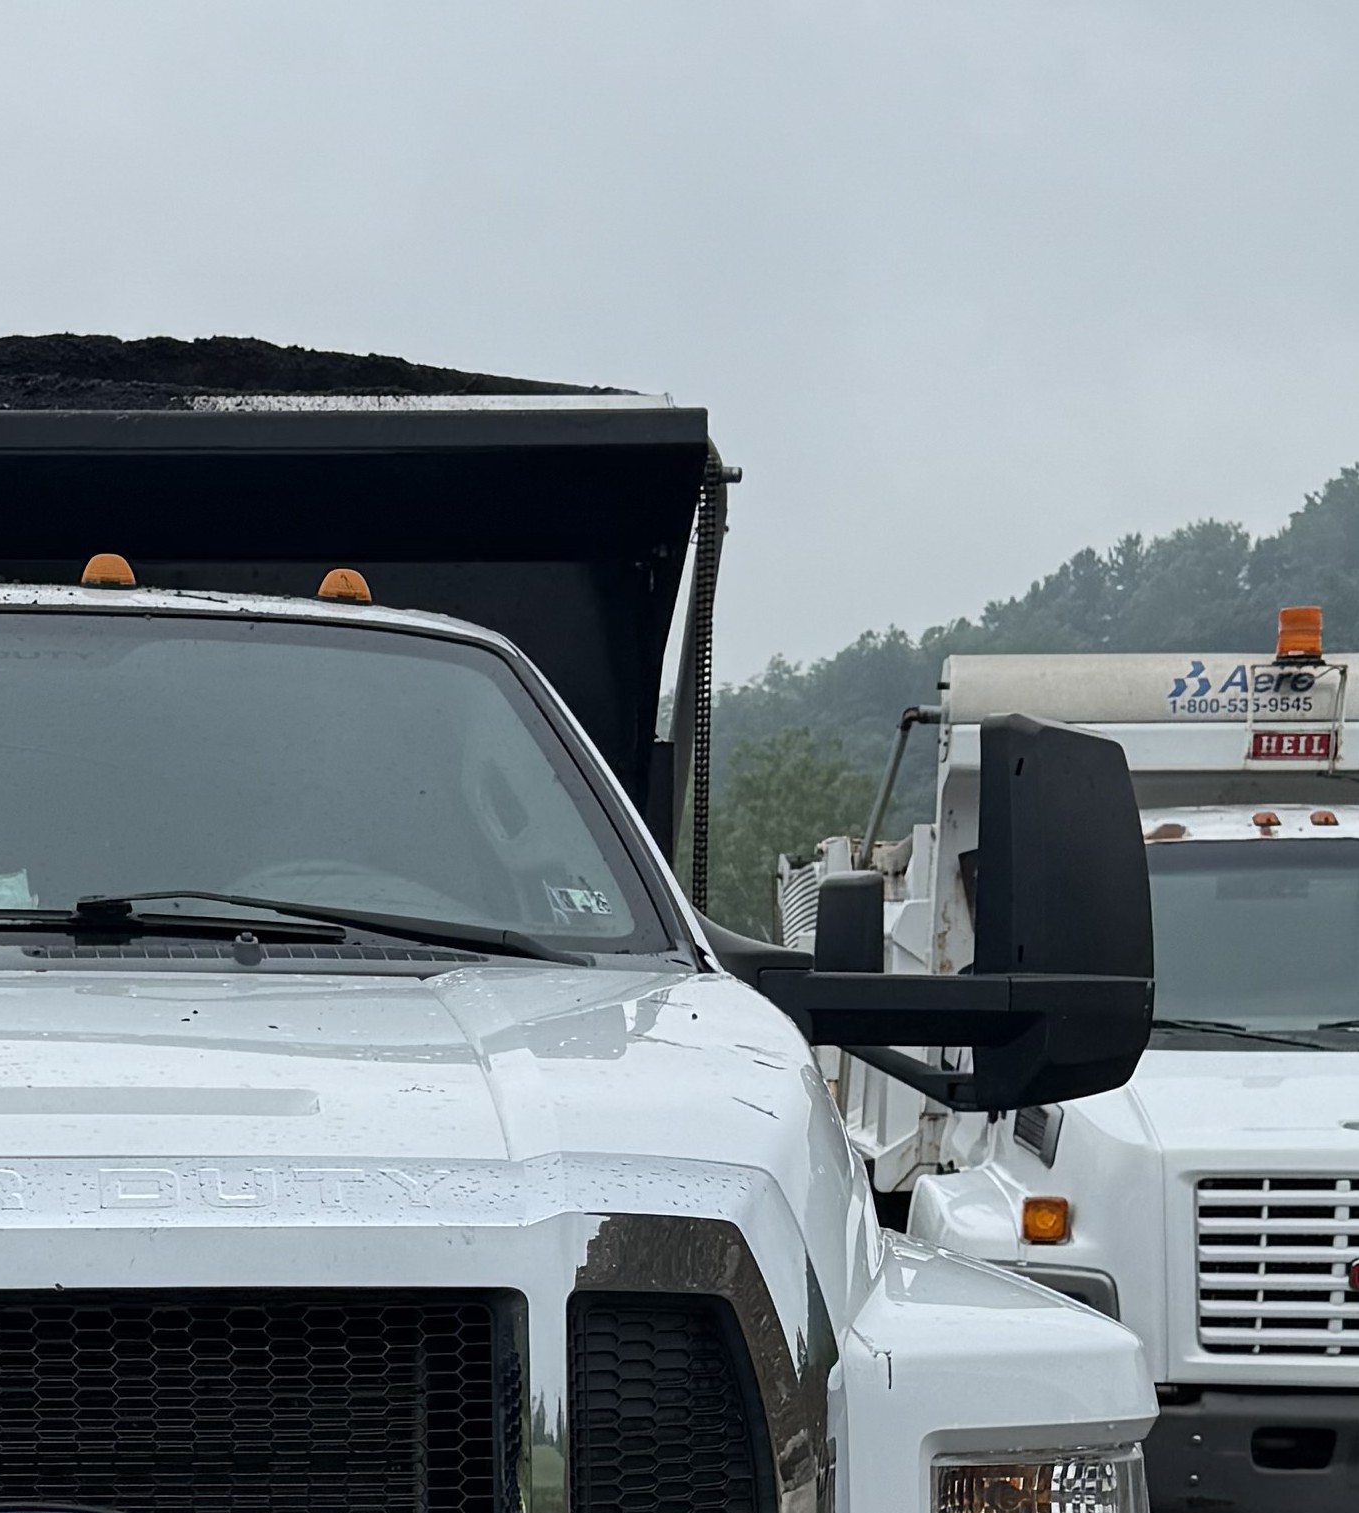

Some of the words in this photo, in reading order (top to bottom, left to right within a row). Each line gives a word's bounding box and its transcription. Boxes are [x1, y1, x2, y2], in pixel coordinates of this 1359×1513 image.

[1218, 664, 1316, 693] Aero
[1169, 696, 1313, 714] 1-800-535-9545
[1259, 735, 1325, 755] HEIL
[98, 1168, 453, 1209] DUTY
